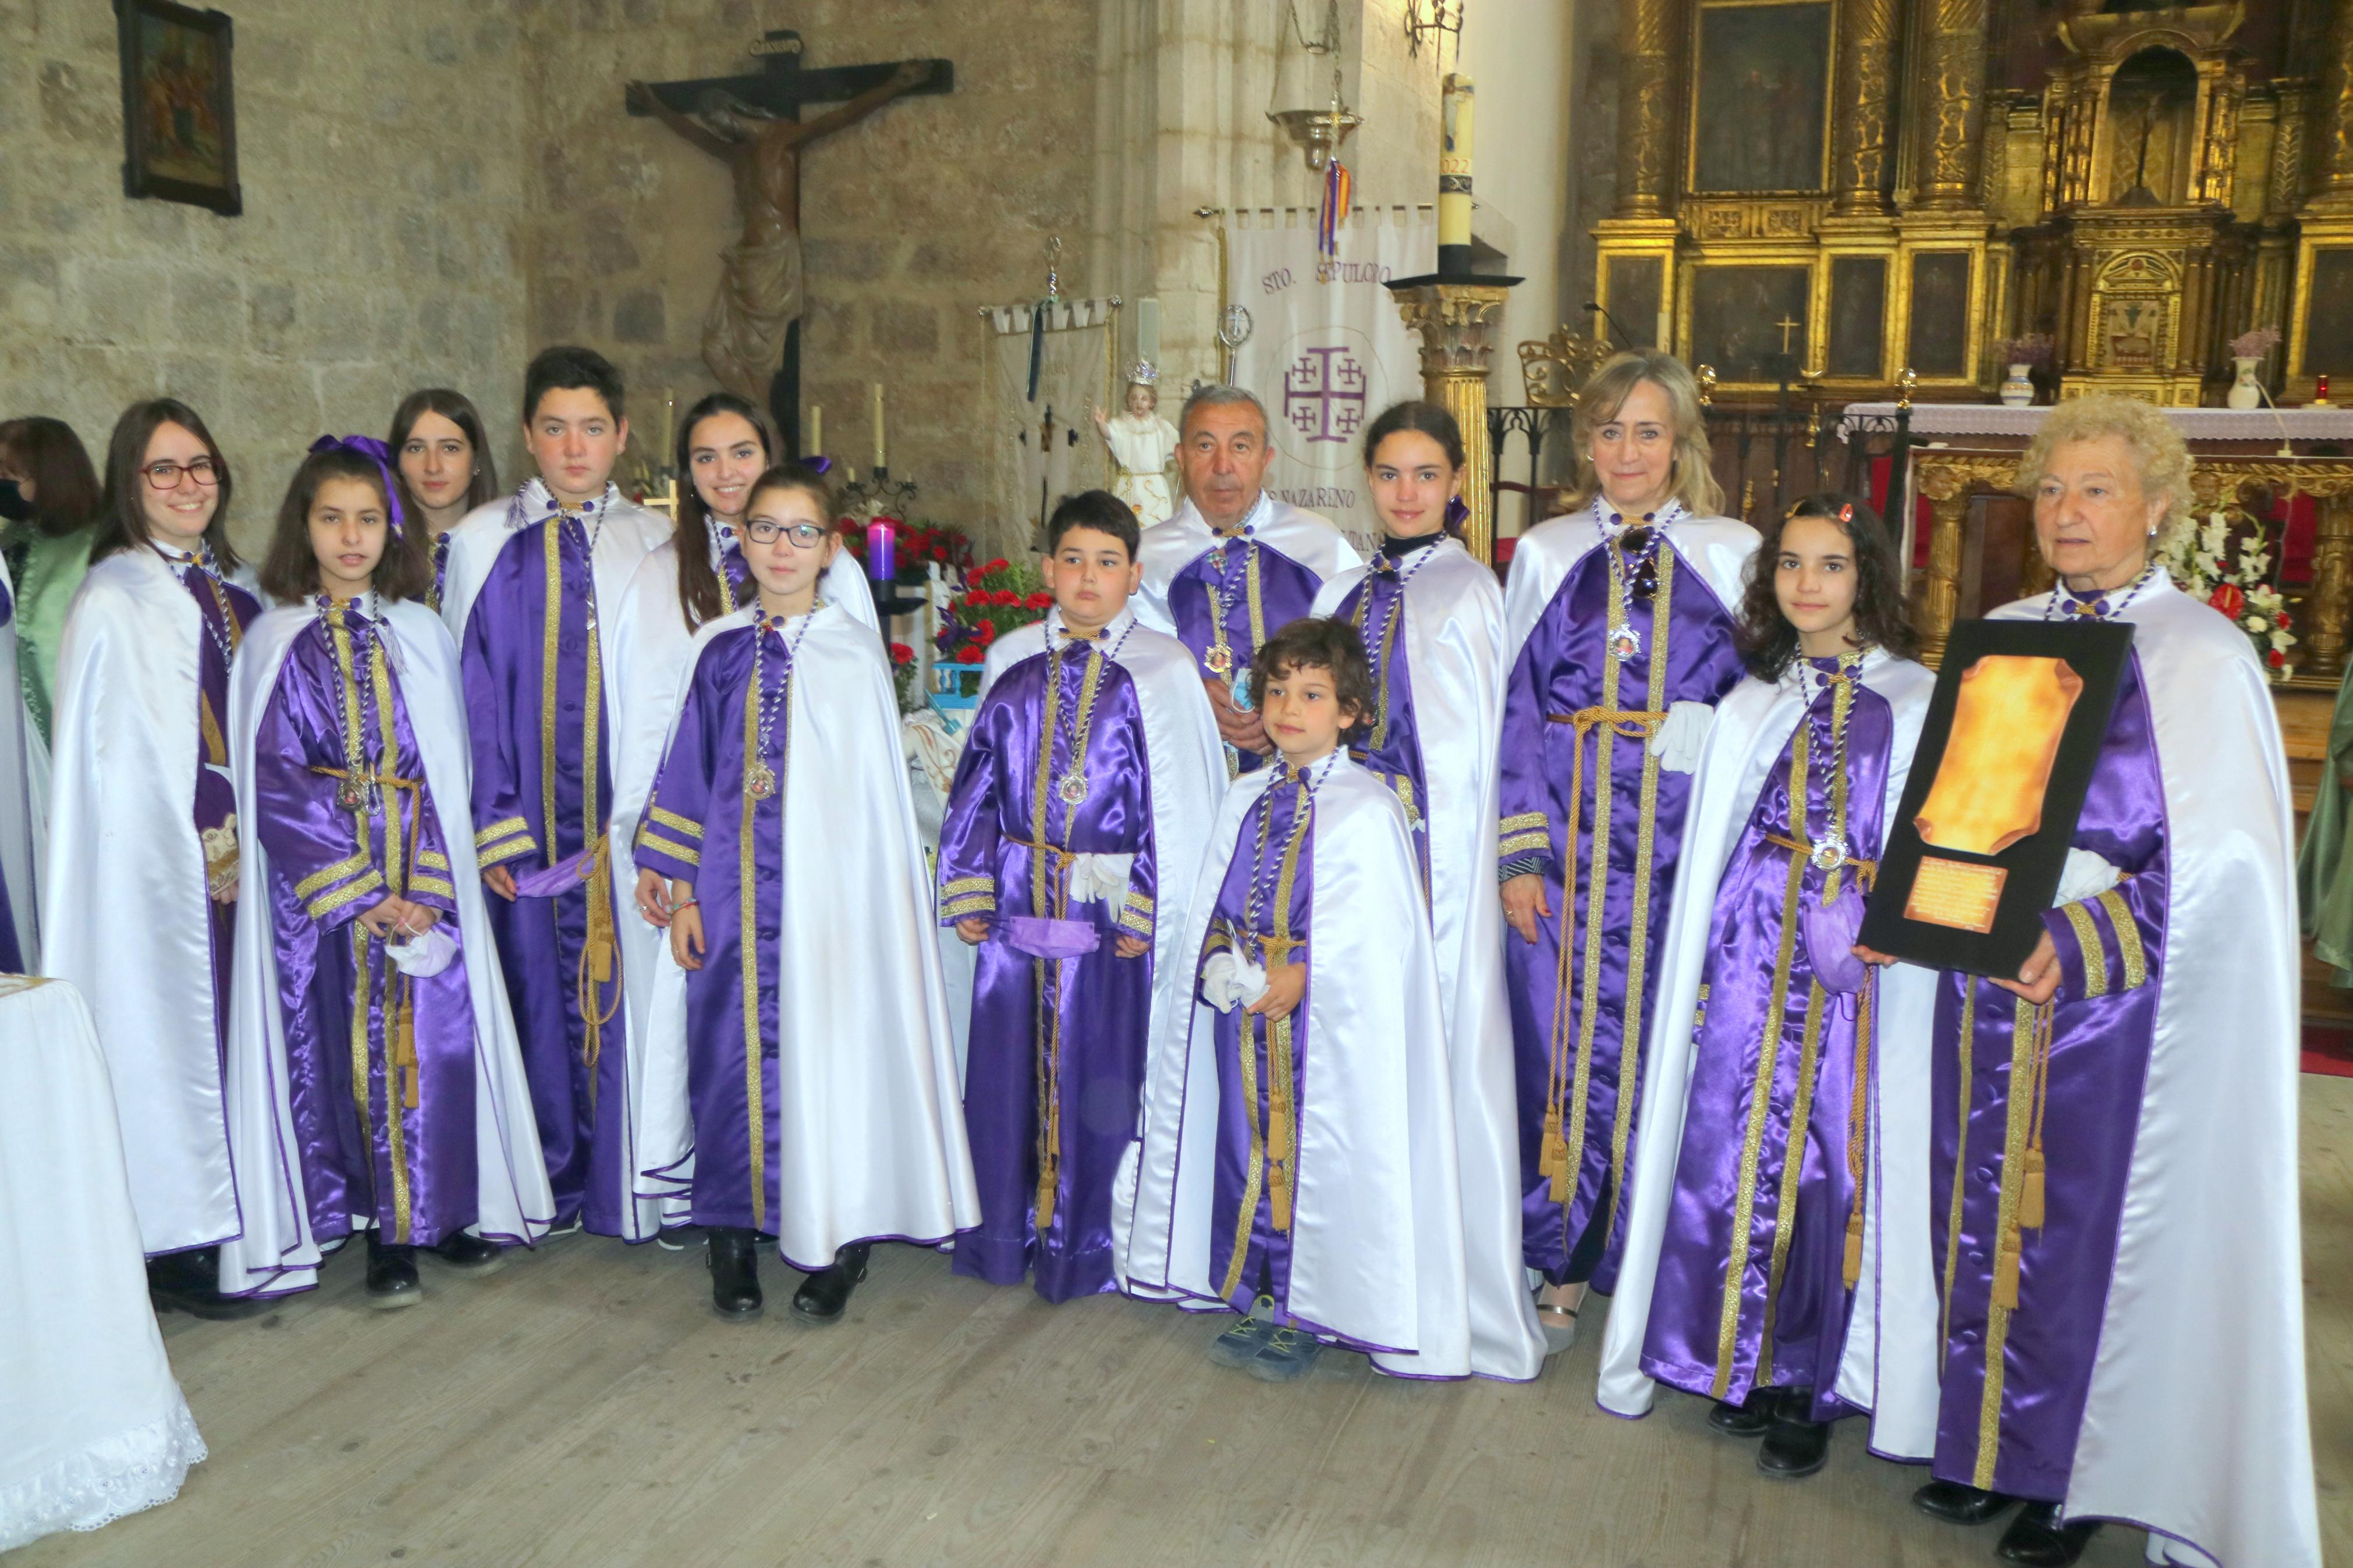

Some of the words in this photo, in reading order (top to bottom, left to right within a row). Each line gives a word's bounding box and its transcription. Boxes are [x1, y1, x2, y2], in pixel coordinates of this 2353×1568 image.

[1440, 158, 1470, 174] 022
[1262, 268, 1296, 295] STO.
[1282, 488, 1355, 508] NAZARENO
